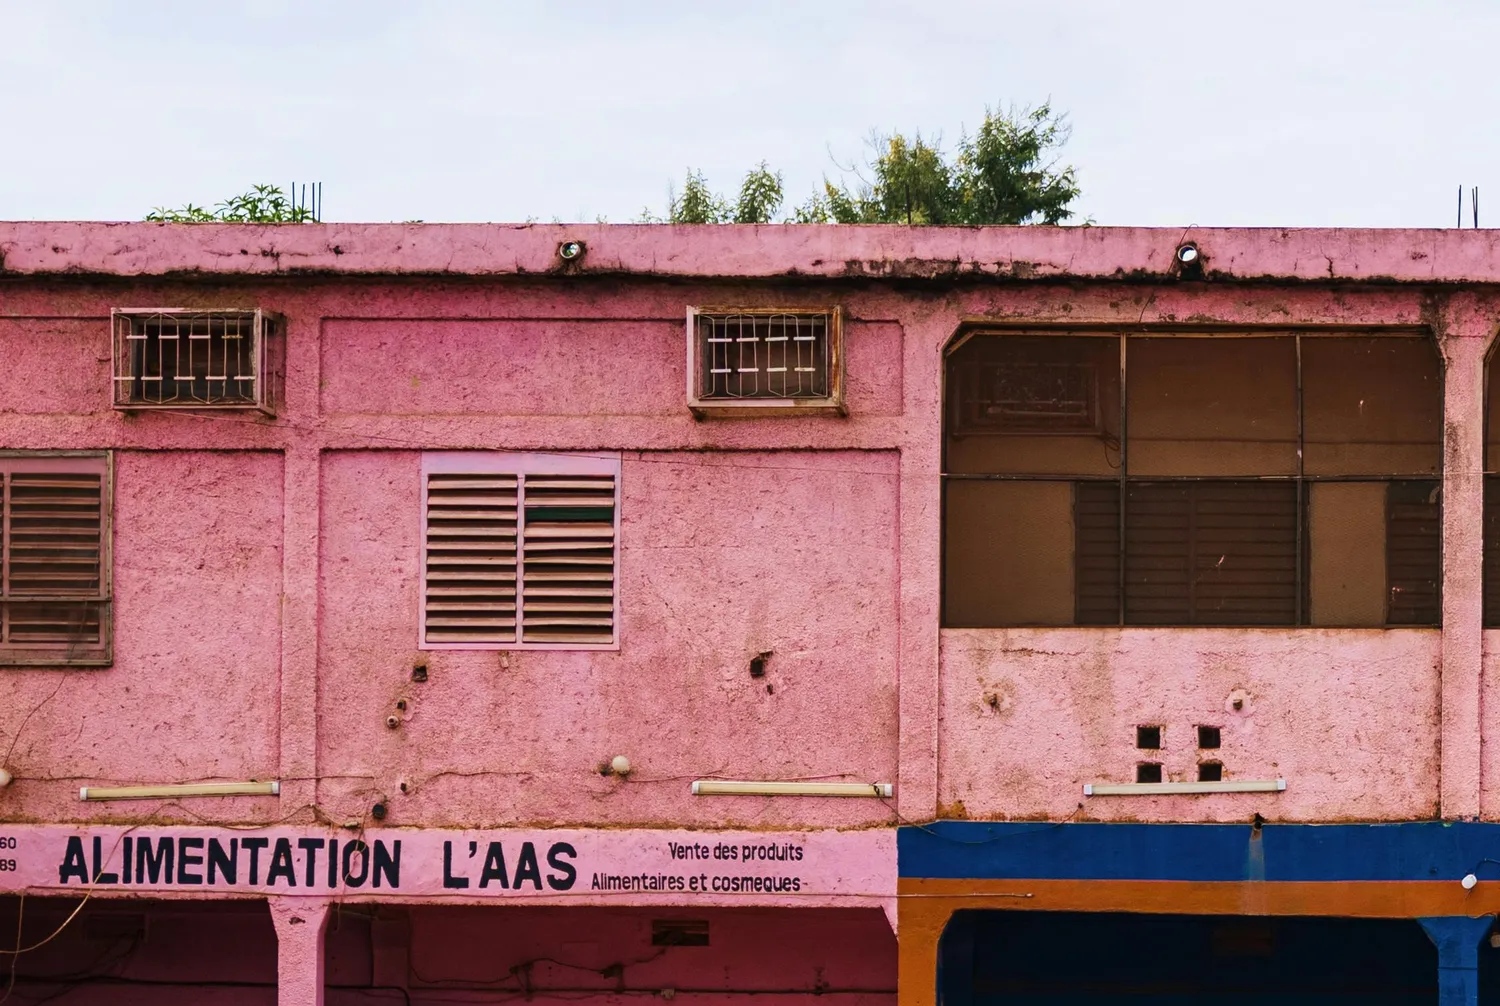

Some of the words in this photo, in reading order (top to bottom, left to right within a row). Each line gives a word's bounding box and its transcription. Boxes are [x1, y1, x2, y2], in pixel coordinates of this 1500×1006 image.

[59, 836, 401, 888] ALIMENTATION
[443, 840, 577, 890] L'AAS
[668, 841, 710, 860] Vente
[713, 841, 739, 861] des
[742, 842, 804, 863] produits
[591, 871, 685, 890] Alimentaires
[689, 873, 707, 892] et
